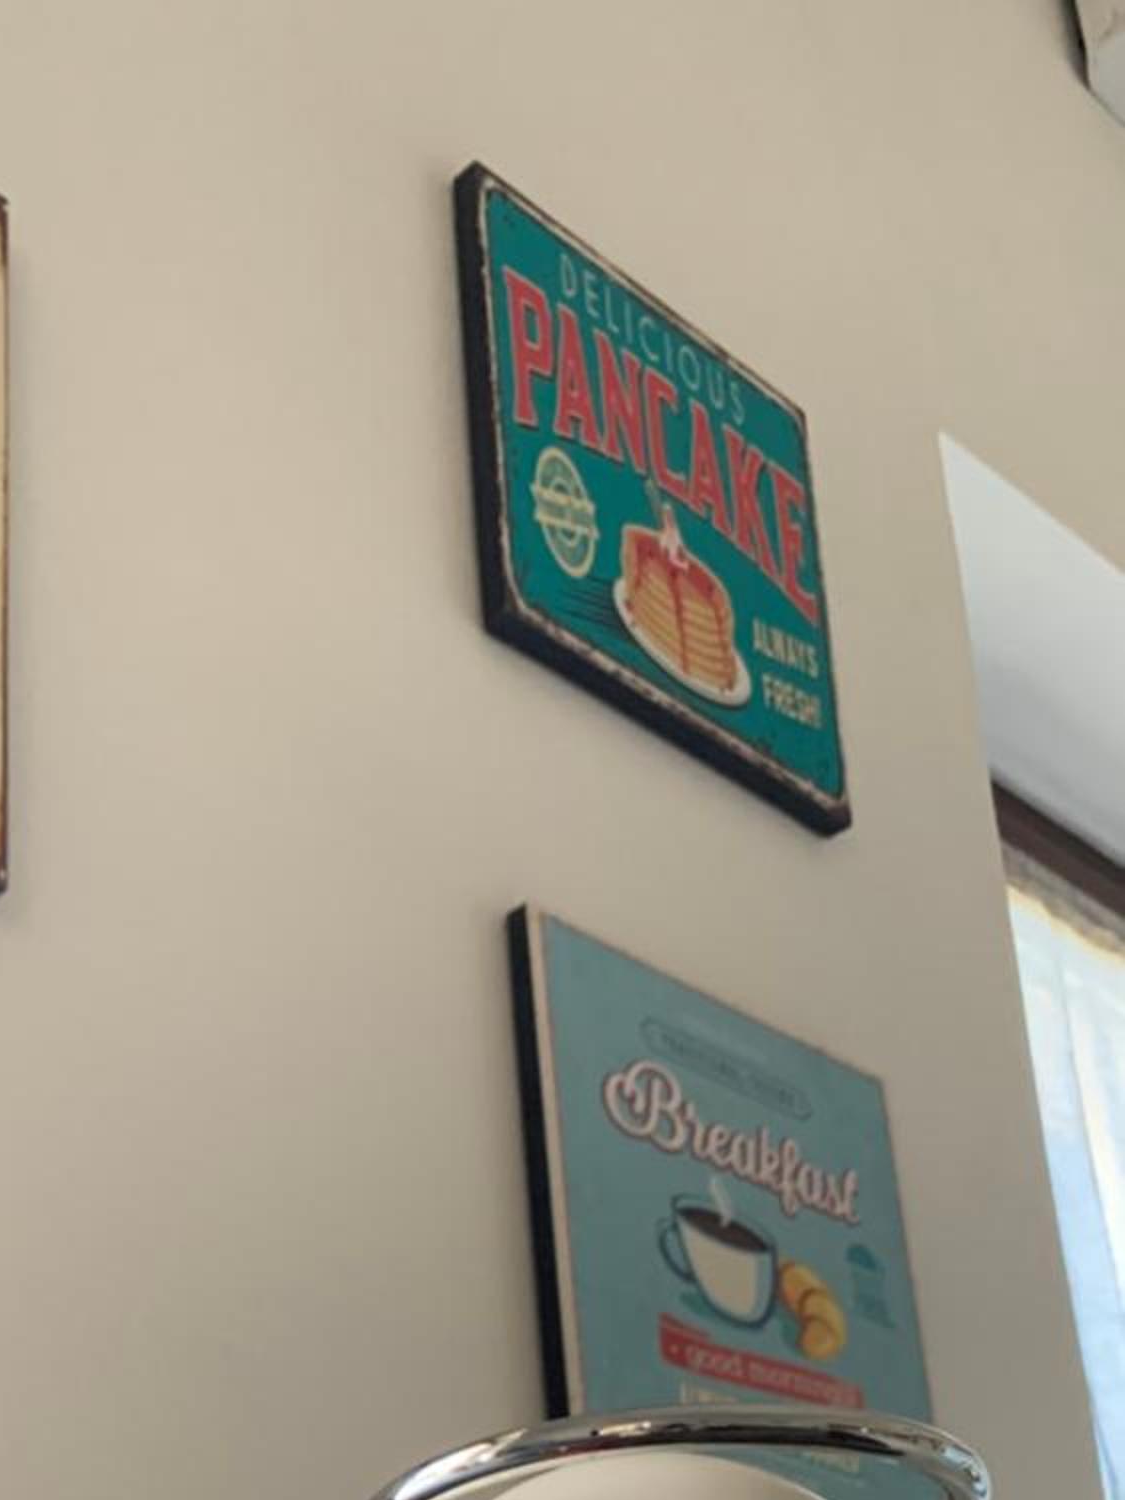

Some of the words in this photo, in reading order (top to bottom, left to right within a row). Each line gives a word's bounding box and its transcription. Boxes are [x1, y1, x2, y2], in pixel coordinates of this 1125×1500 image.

[559, 252, 746, 426] DELICIOUS
[501, 264, 820, 627] PANCAKE
[600, 1057, 860, 1226] Breakfast
